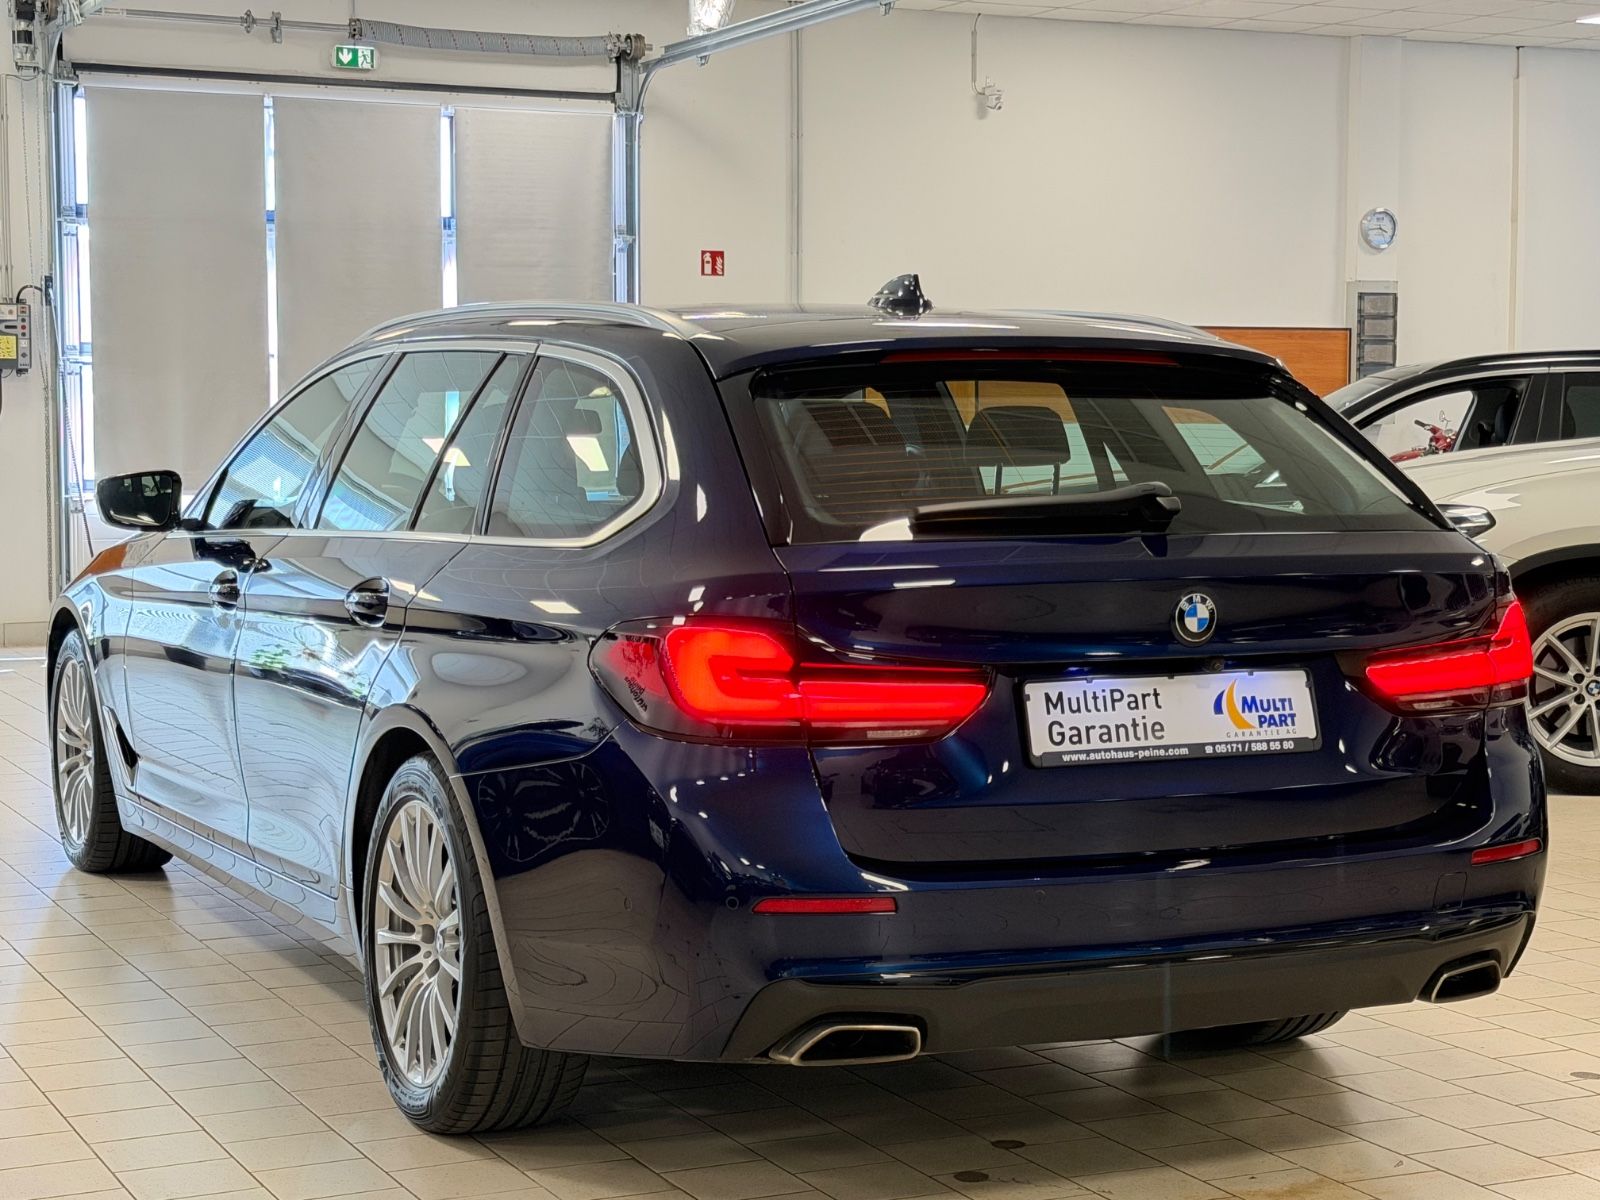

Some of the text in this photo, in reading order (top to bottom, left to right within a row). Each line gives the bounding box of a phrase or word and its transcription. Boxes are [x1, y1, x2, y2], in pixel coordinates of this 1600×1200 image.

[1180, 594, 1214, 611] BMW
[1044, 687, 1162, 715] MultiPart
[1242, 696, 1293, 713] MULTI
[1258, 713, 1296, 728] PART
[1048, 715, 1165, 746] Garantie
[1227, 729, 1279, 738] GARANTIE
[1062, 746, 1189, 762] www.autohaus-peine.com
[1215, 744, 1242, 752] 05171
[1283, 741, 1294, 749] 80
